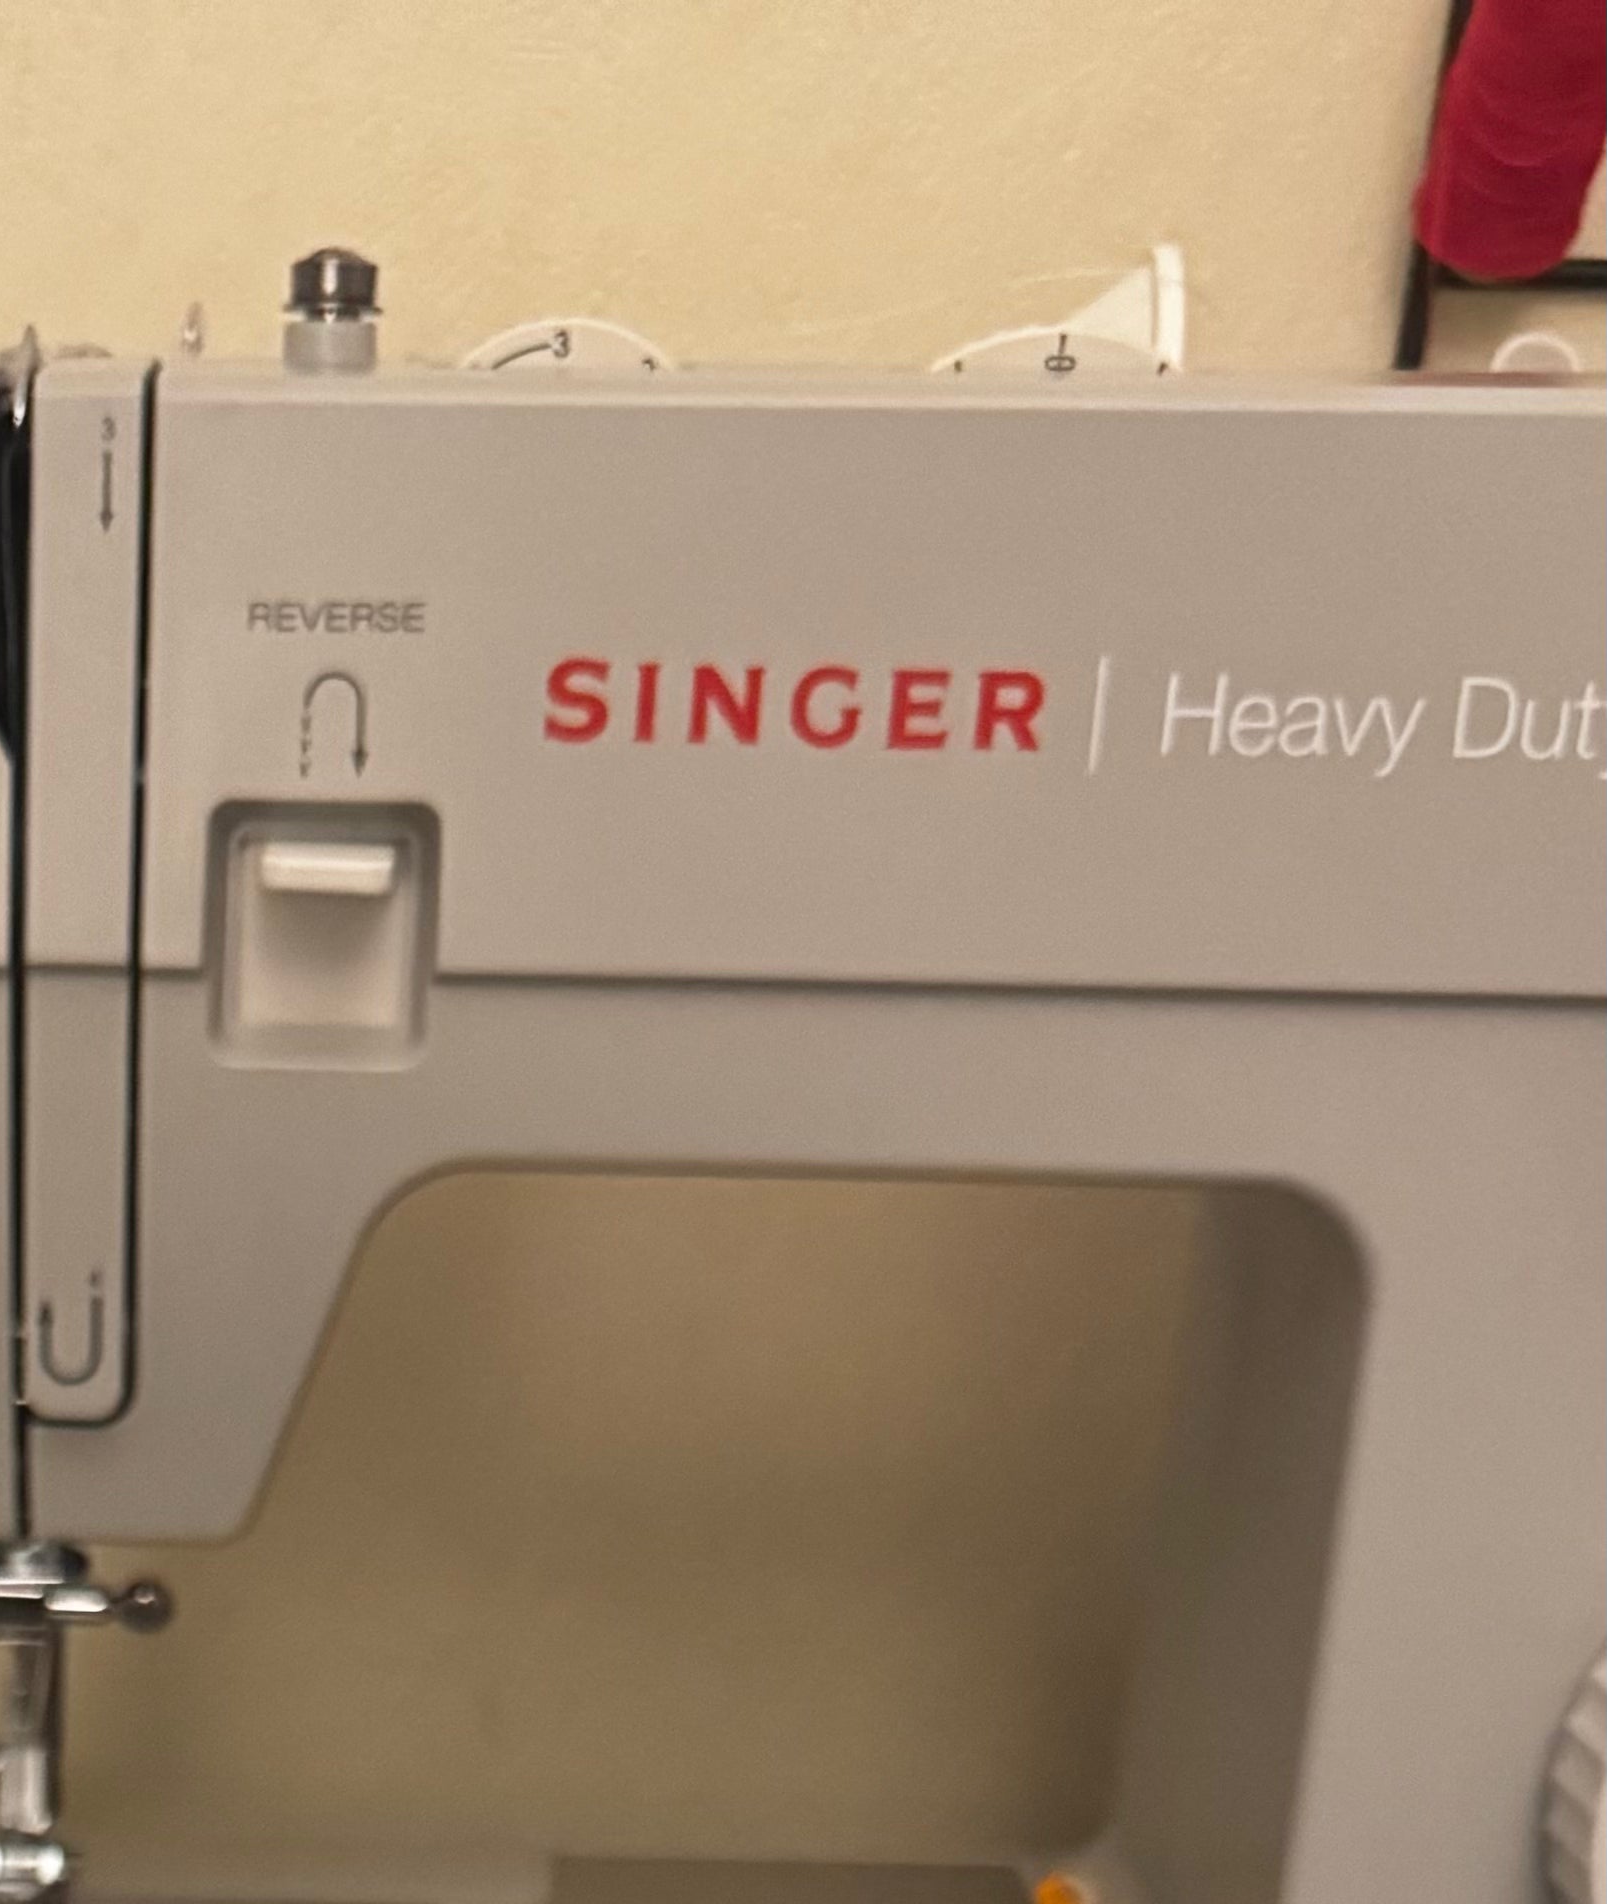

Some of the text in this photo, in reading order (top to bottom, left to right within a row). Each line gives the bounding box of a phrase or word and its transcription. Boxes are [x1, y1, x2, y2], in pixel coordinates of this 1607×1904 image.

[247, 601, 427, 634] REVERSE
[543, 656, 1607, 780] SINGER Heavy Dut
